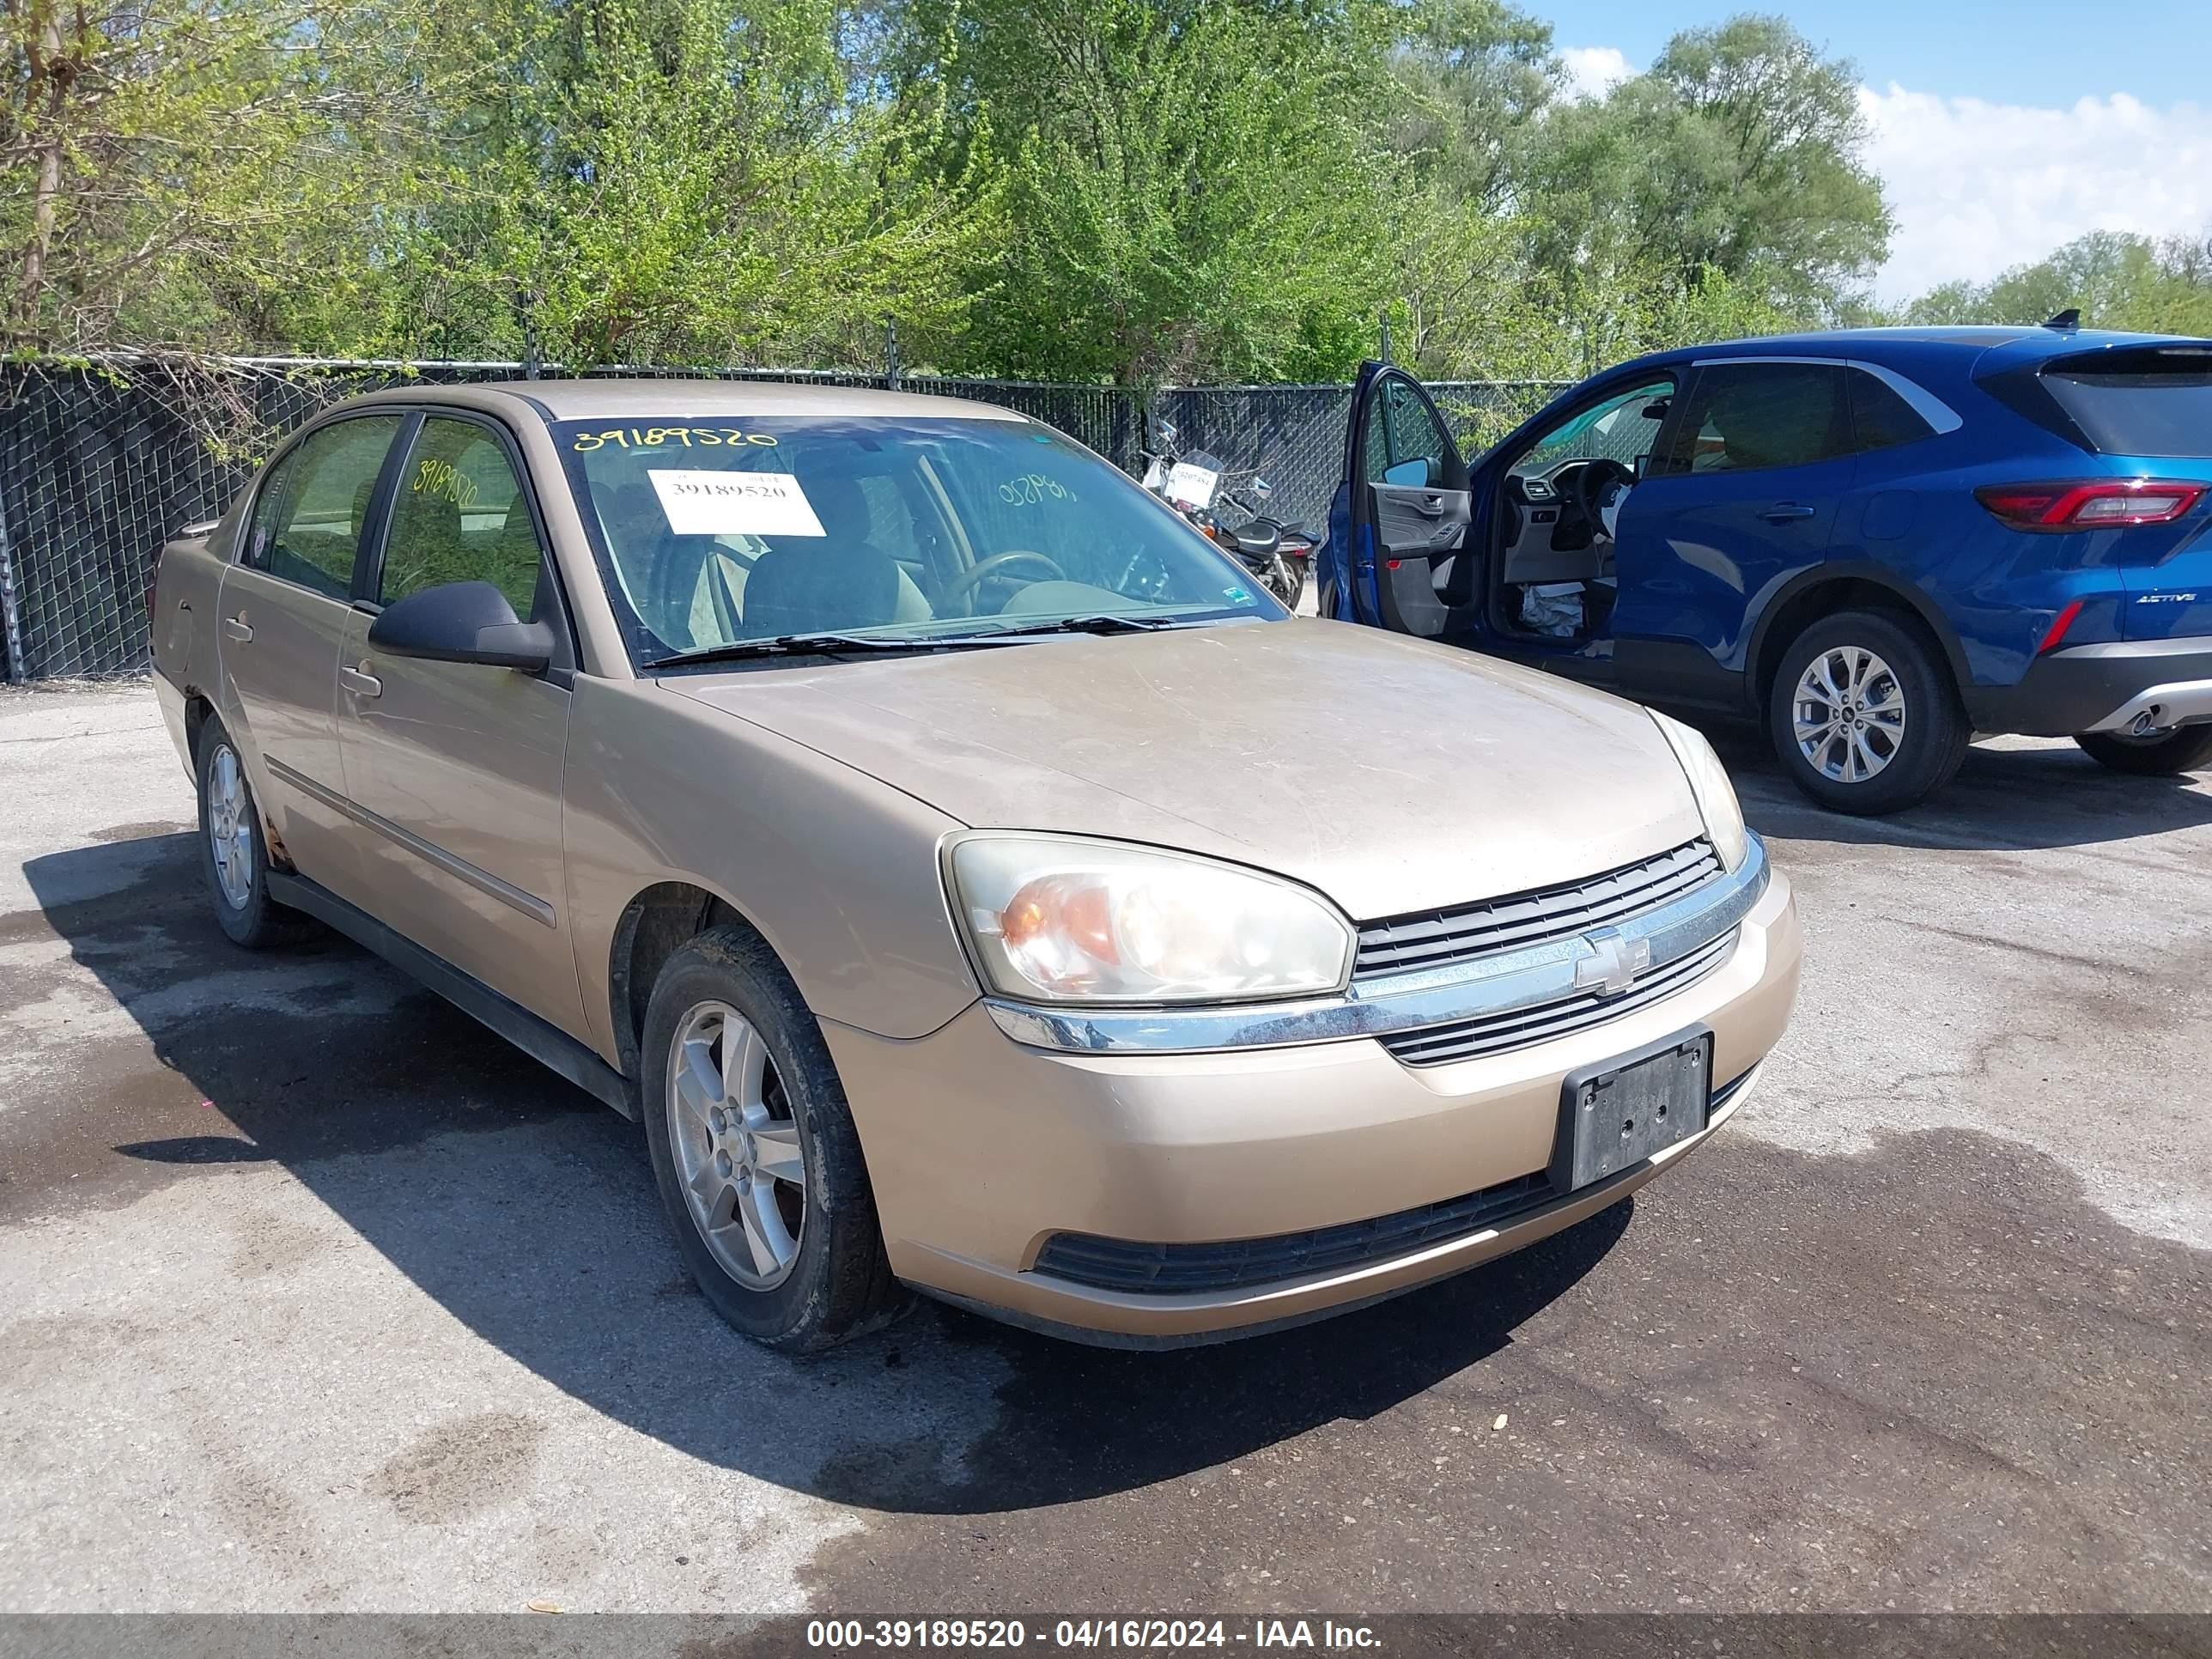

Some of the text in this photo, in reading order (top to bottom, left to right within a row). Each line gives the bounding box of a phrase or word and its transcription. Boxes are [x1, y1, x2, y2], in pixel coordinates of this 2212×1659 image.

[574, 428, 779, 452] 39189520
[672, 483, 787, 498] 39189520
[2136, 593, 2198, 604] ACTIVE
